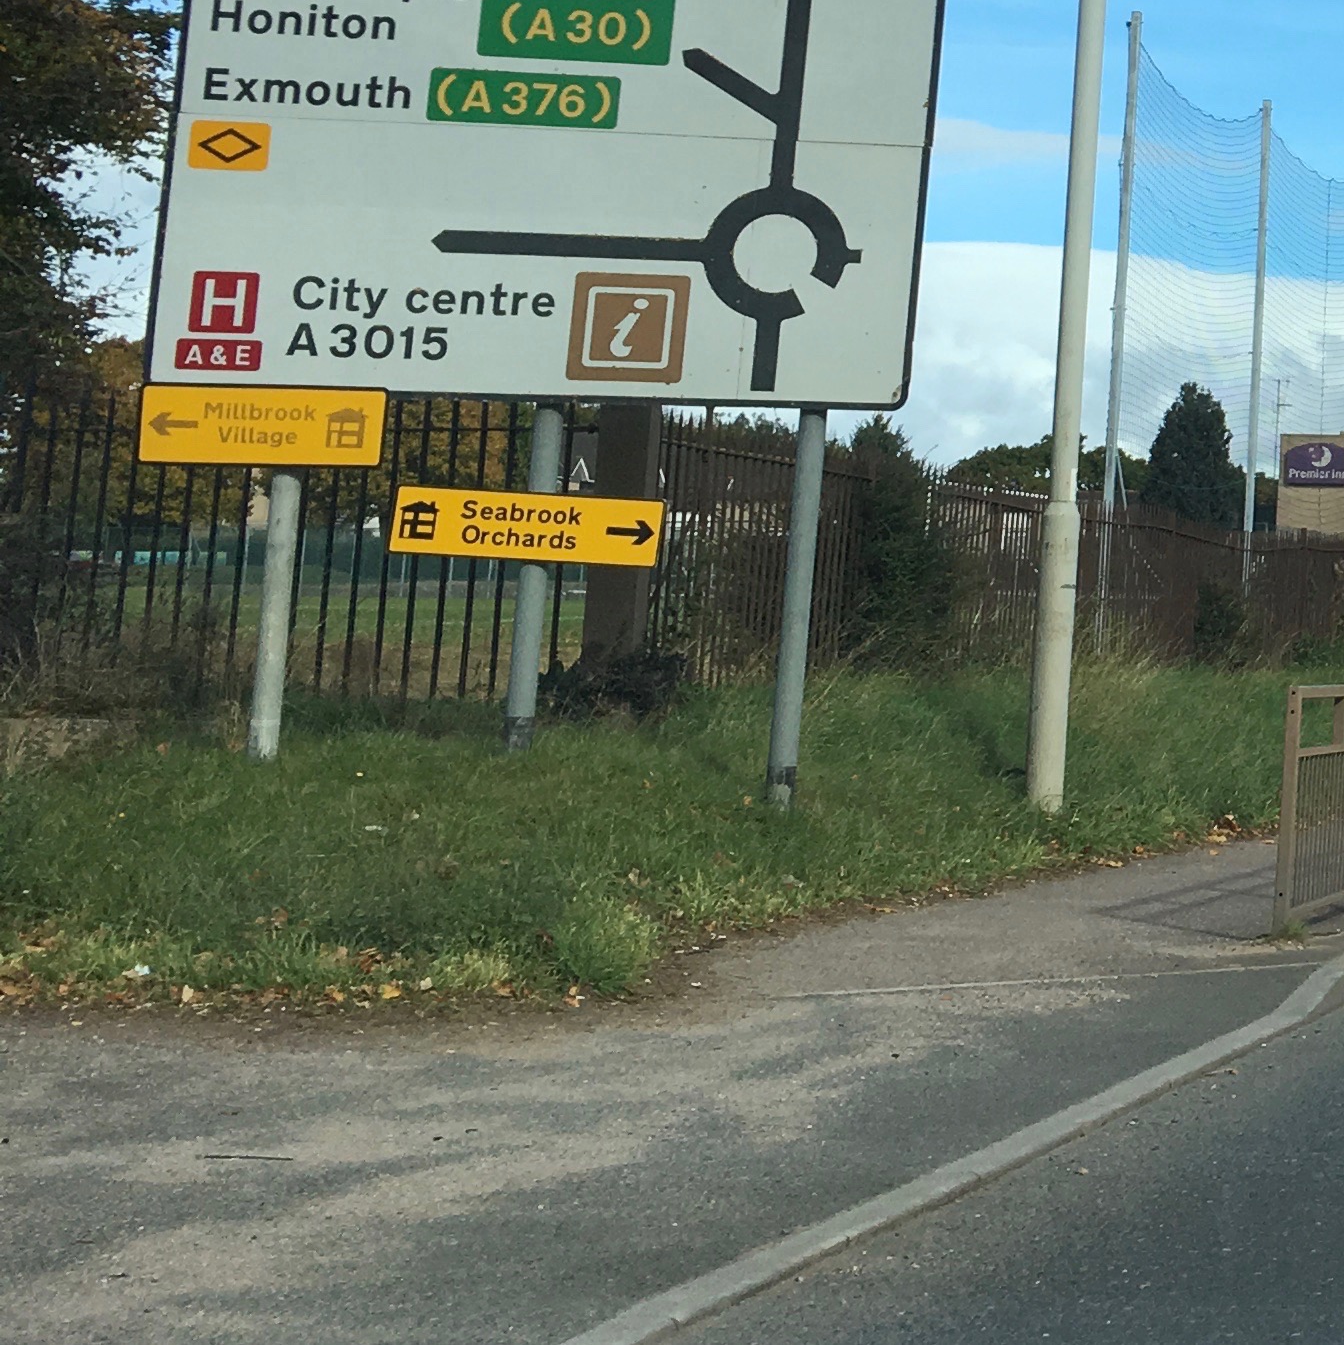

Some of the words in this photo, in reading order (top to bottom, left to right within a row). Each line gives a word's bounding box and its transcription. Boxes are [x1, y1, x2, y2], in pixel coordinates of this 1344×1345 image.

[210, 0, 397, 42] Honiton
[500, 1, 653, 51] (A30)
[202, 67, 411, 110] Exmouth
[436, 71, 613, 122] (A376)
[200, 278, 249, 327] H
[292, 275, 388, 319] City
[405, 282, 557, 319] centre
[285, 324, 450, 362] A3015
[203, 402, 318, 422] Millbrook
[218, 426, 298, 448] Village
[1288, 468, 1331, 479] Premier
[460, 500, 583, 526] Seabrook
[461, 524, 577, 550] Orchards
